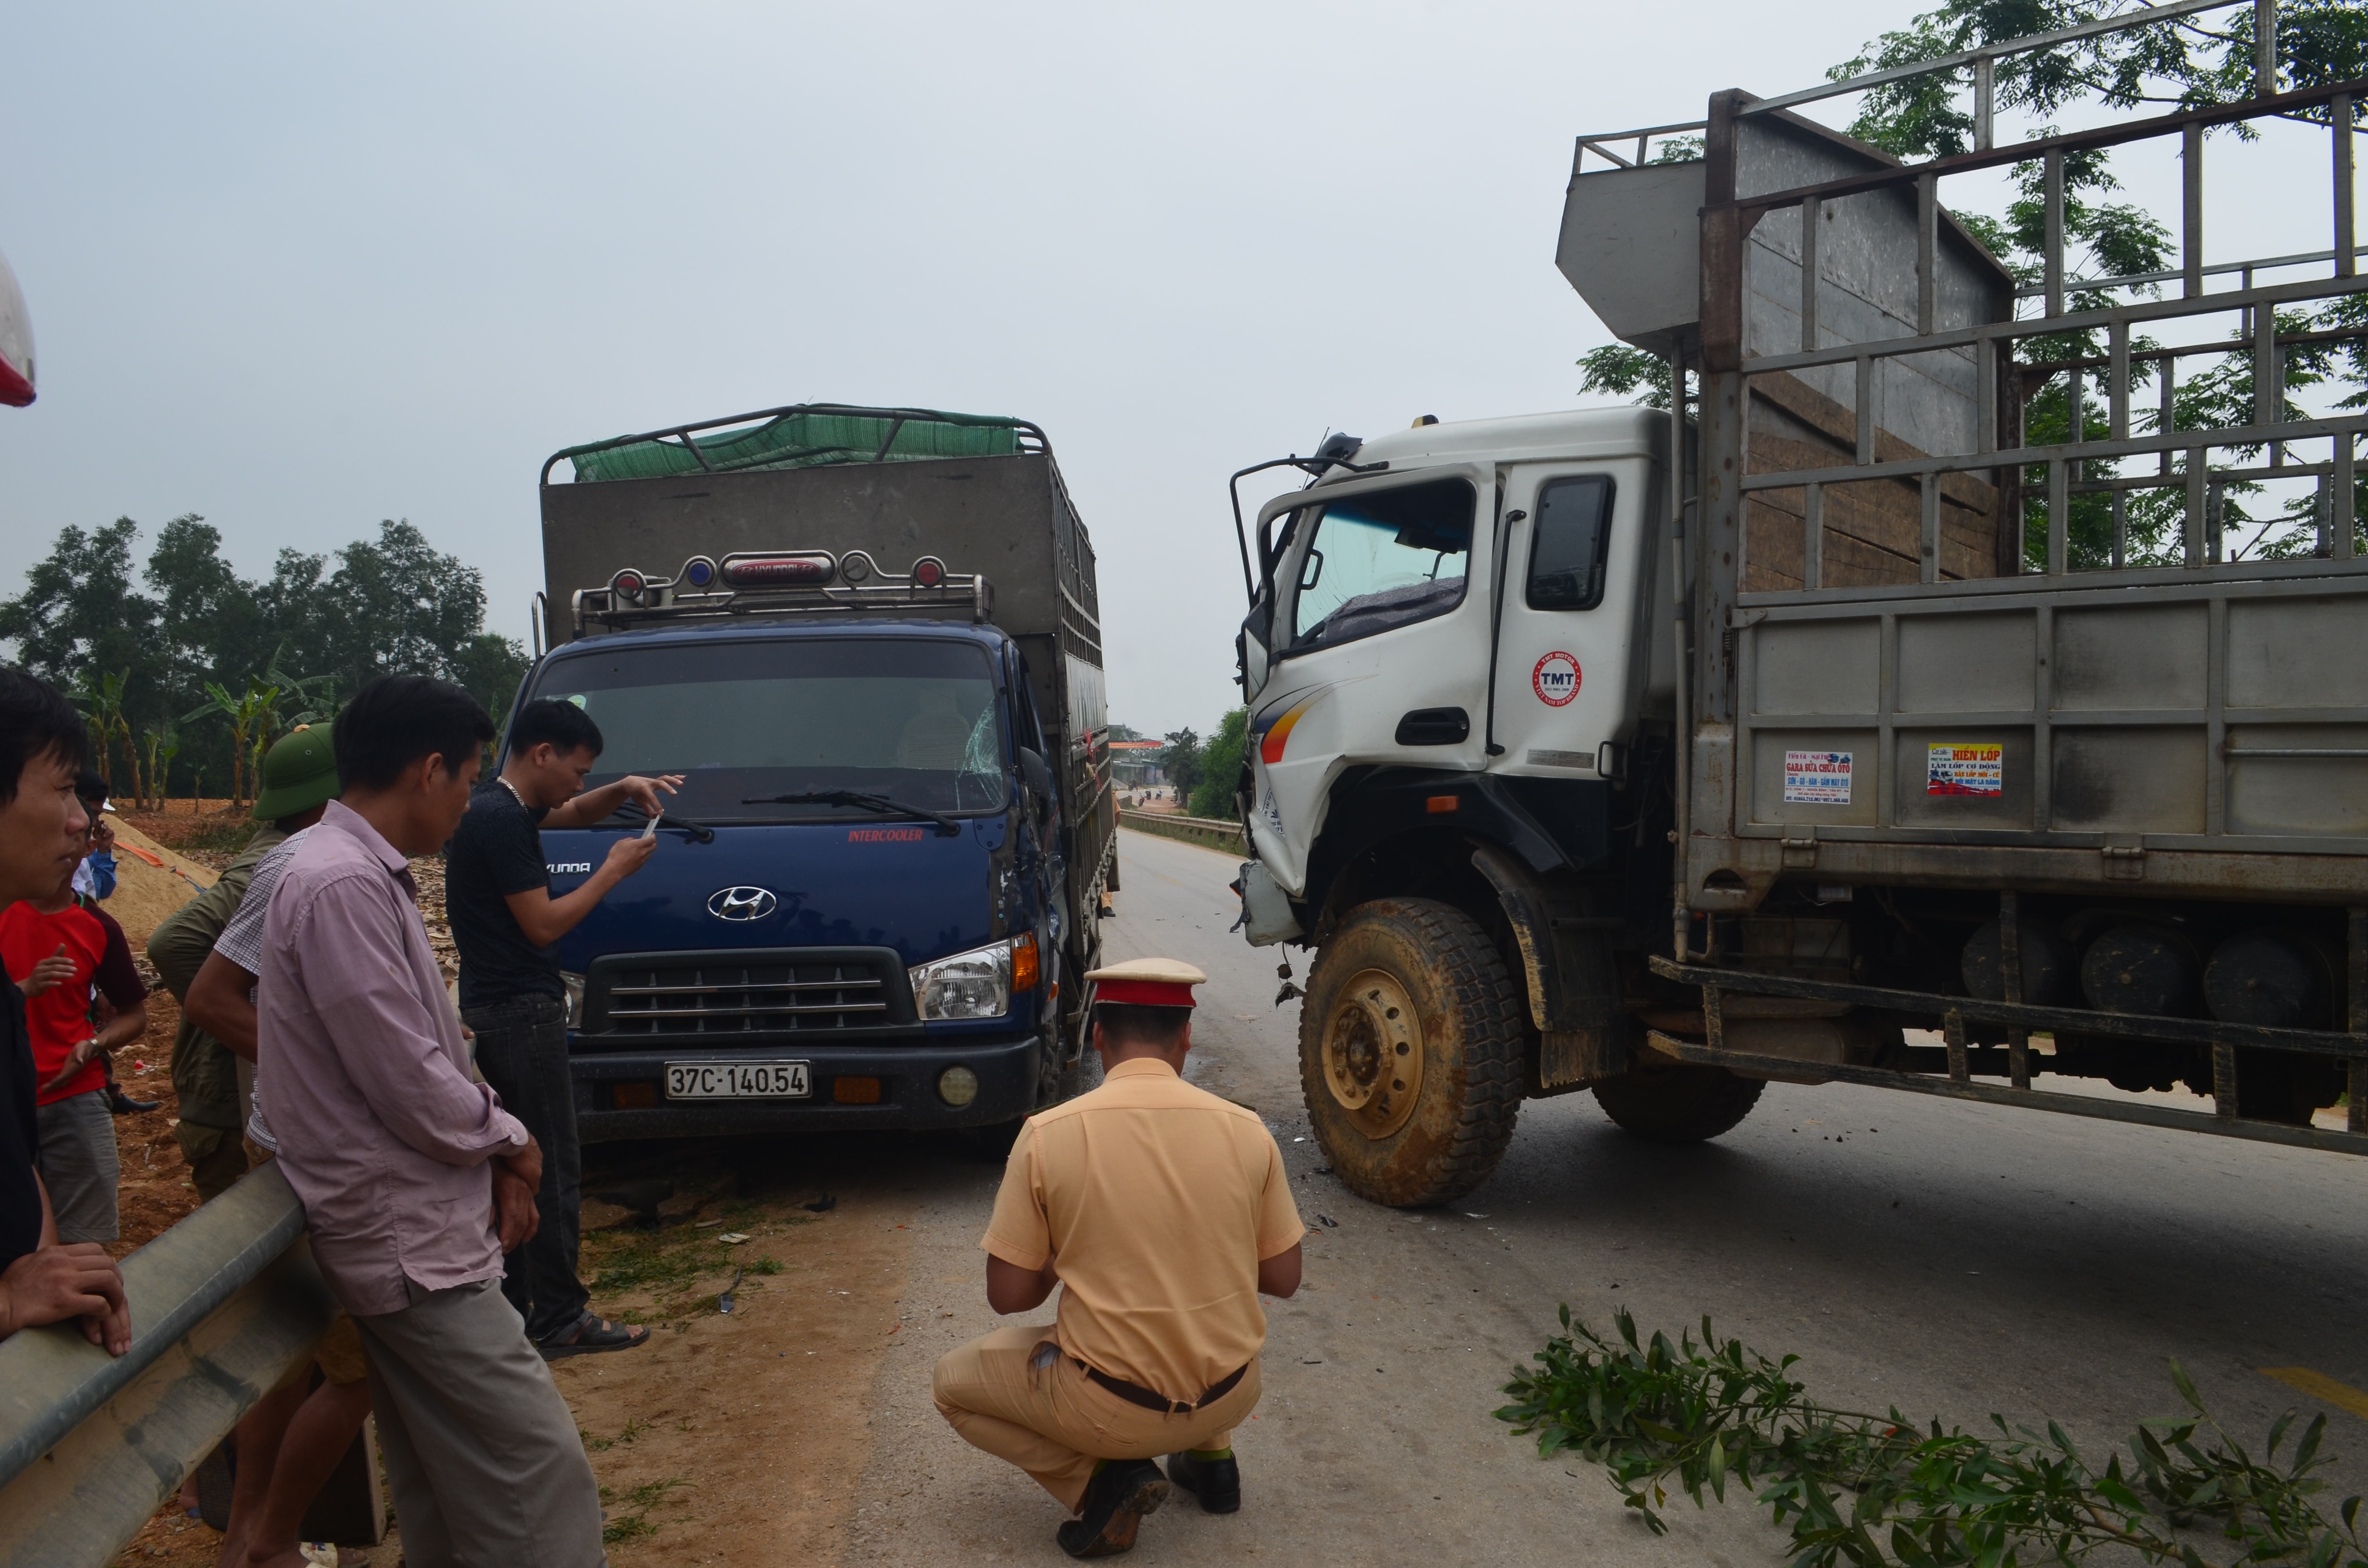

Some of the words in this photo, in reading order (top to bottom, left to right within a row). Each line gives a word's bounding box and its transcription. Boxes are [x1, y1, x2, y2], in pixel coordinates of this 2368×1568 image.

[755, 564, 798, 576] HYUNDAI
[1542, 654, 1553, 663] TMT
[1555, 653, 1575, 664] MOTOR
[1541, 673, 1574, 685] TMT
[1535, 684, 1545, 698] VIET
[1545, 697, 1555, 706] NAM
[1566, 684, 1579, 701] BRAND
[1952, 746, 1977, 760] HIỂN
[1980, 747, 2000, 761] LỐP
[1787, 763, 1803, 772] GARA
[1805, 760, 1817, 772] SỬA
[1979, 763, 2000, 771] ĐỘNG
[848, 829, 924, 842] INTERCOOLER
[671, 1067, 804, 1093] 37C-140.54
